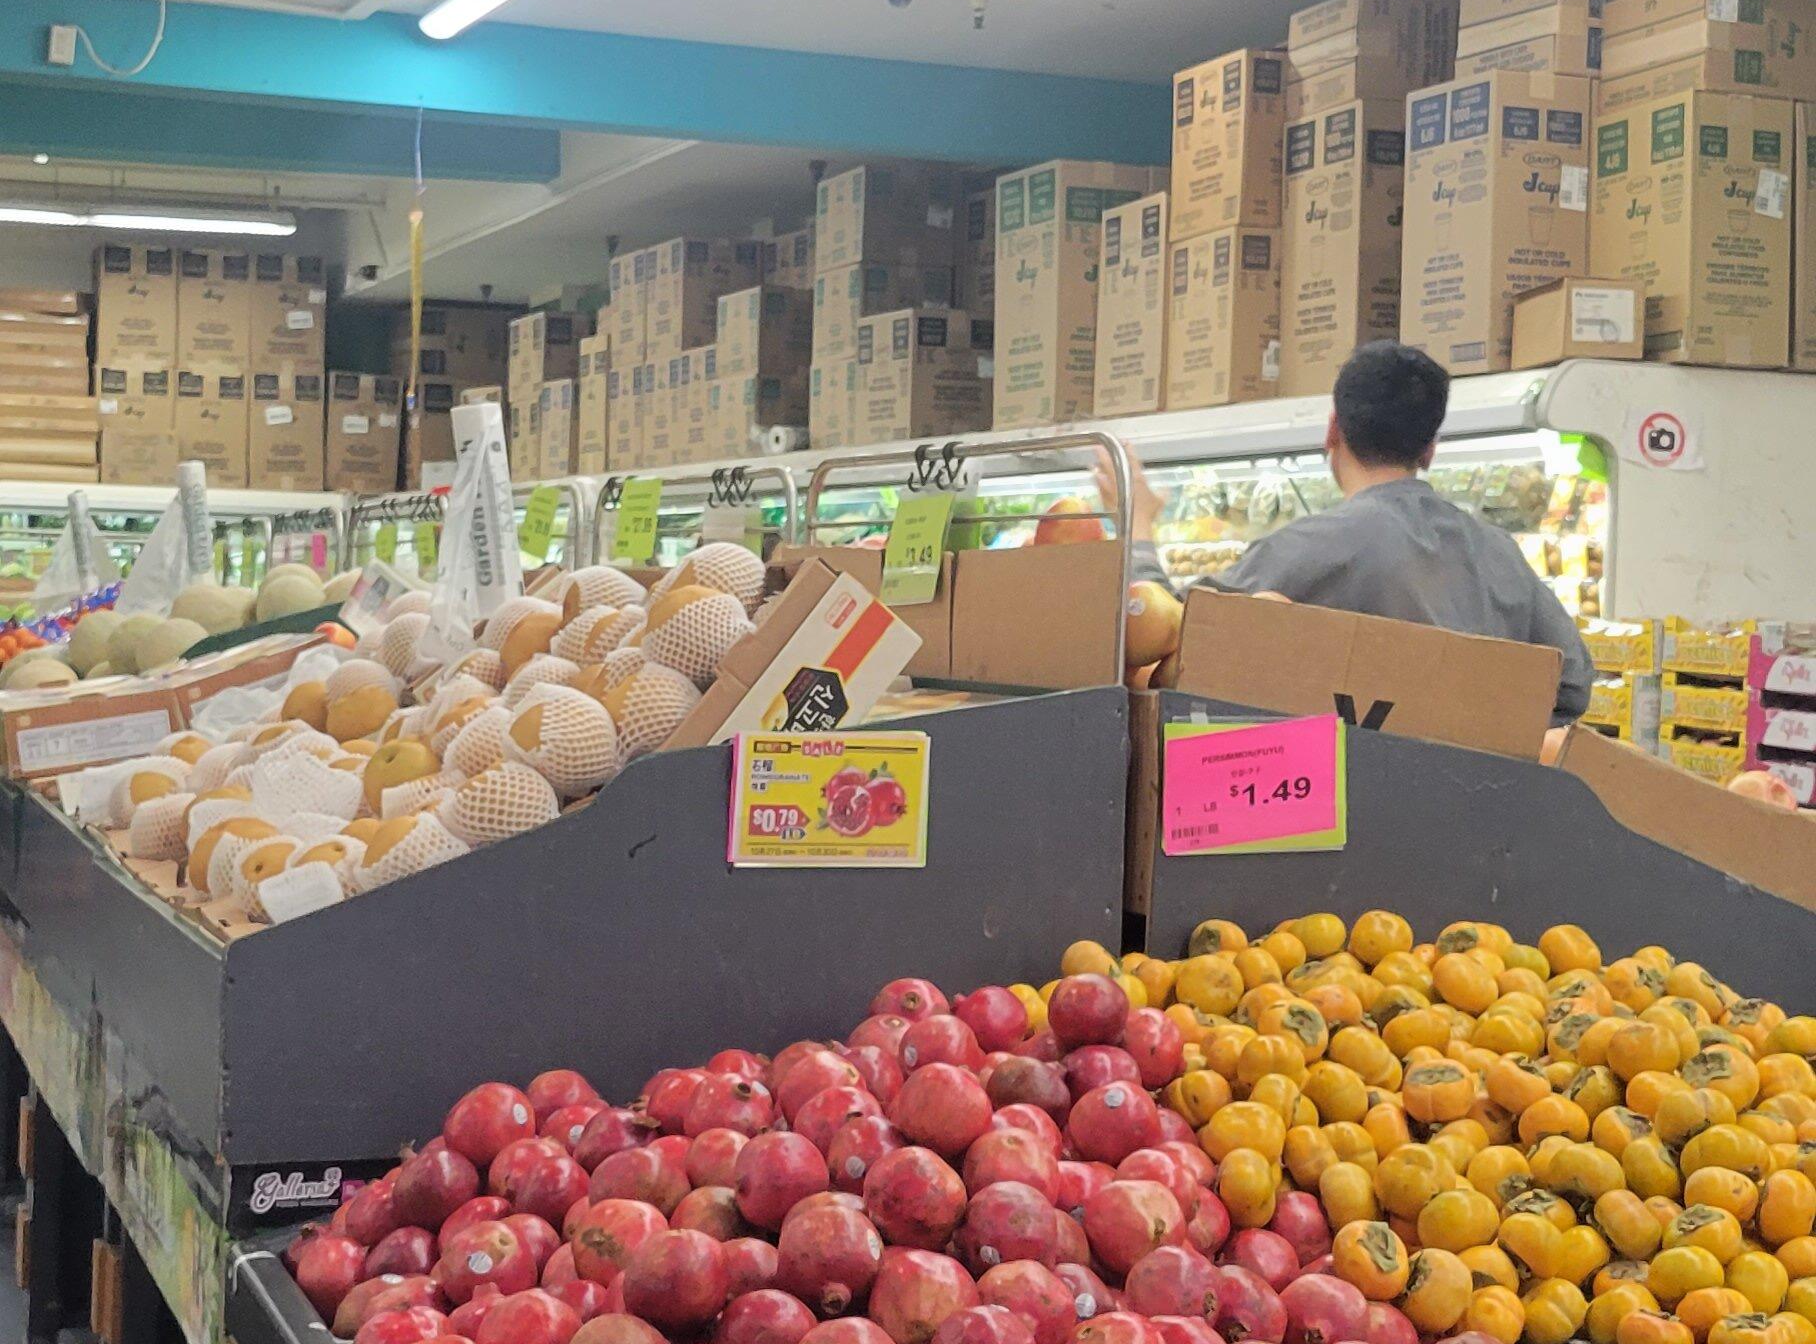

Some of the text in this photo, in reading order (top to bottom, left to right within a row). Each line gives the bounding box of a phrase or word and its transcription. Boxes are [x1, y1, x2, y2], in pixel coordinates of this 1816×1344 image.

[783, 684, 835, 732] 신고
[1230, 776, 1311, 806] $1.49
[753, 808, 798, 833] $0.79
